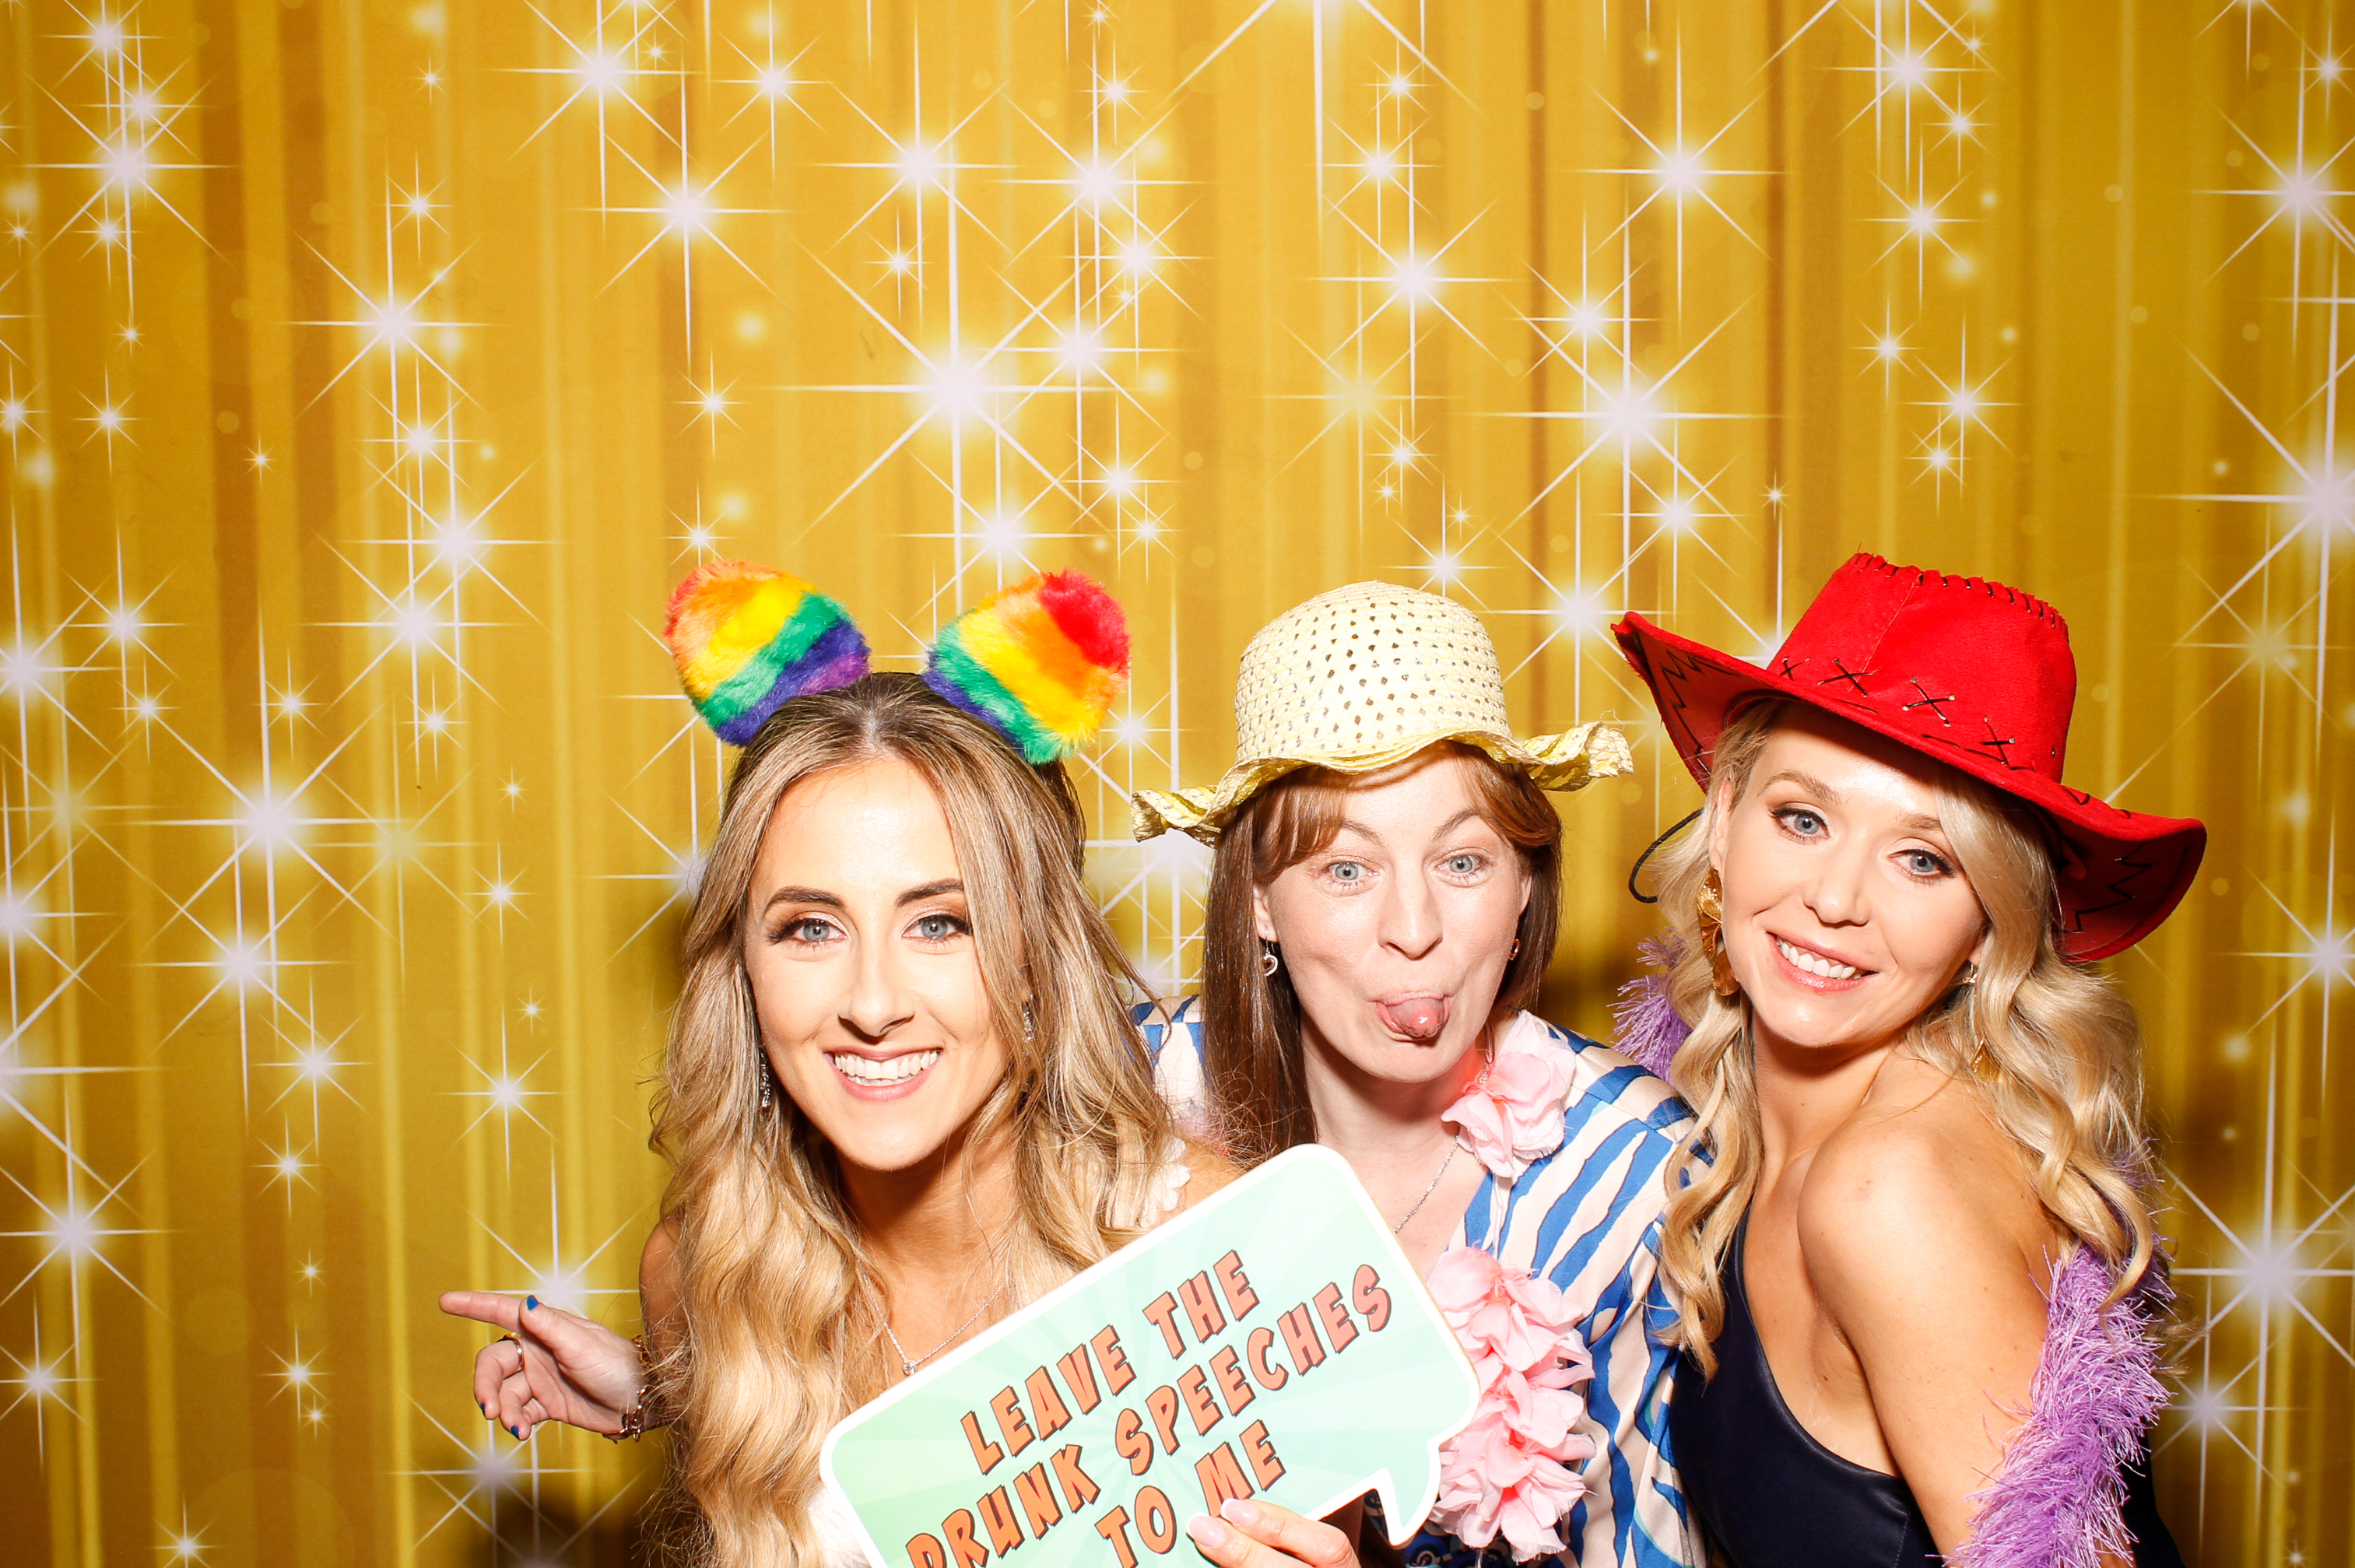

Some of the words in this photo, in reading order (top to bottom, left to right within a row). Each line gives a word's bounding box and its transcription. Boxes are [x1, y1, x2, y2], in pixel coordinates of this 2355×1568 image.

[960, 1324, 1136, 1475] LEAVE
[1142, 1250, 1259, 1359] THE
[1115, 1264, 1392, 1476] SPEECHES
[1095, 1486, 1177, 1568] TO
[1195, 1419, 1286, 1517] ME
